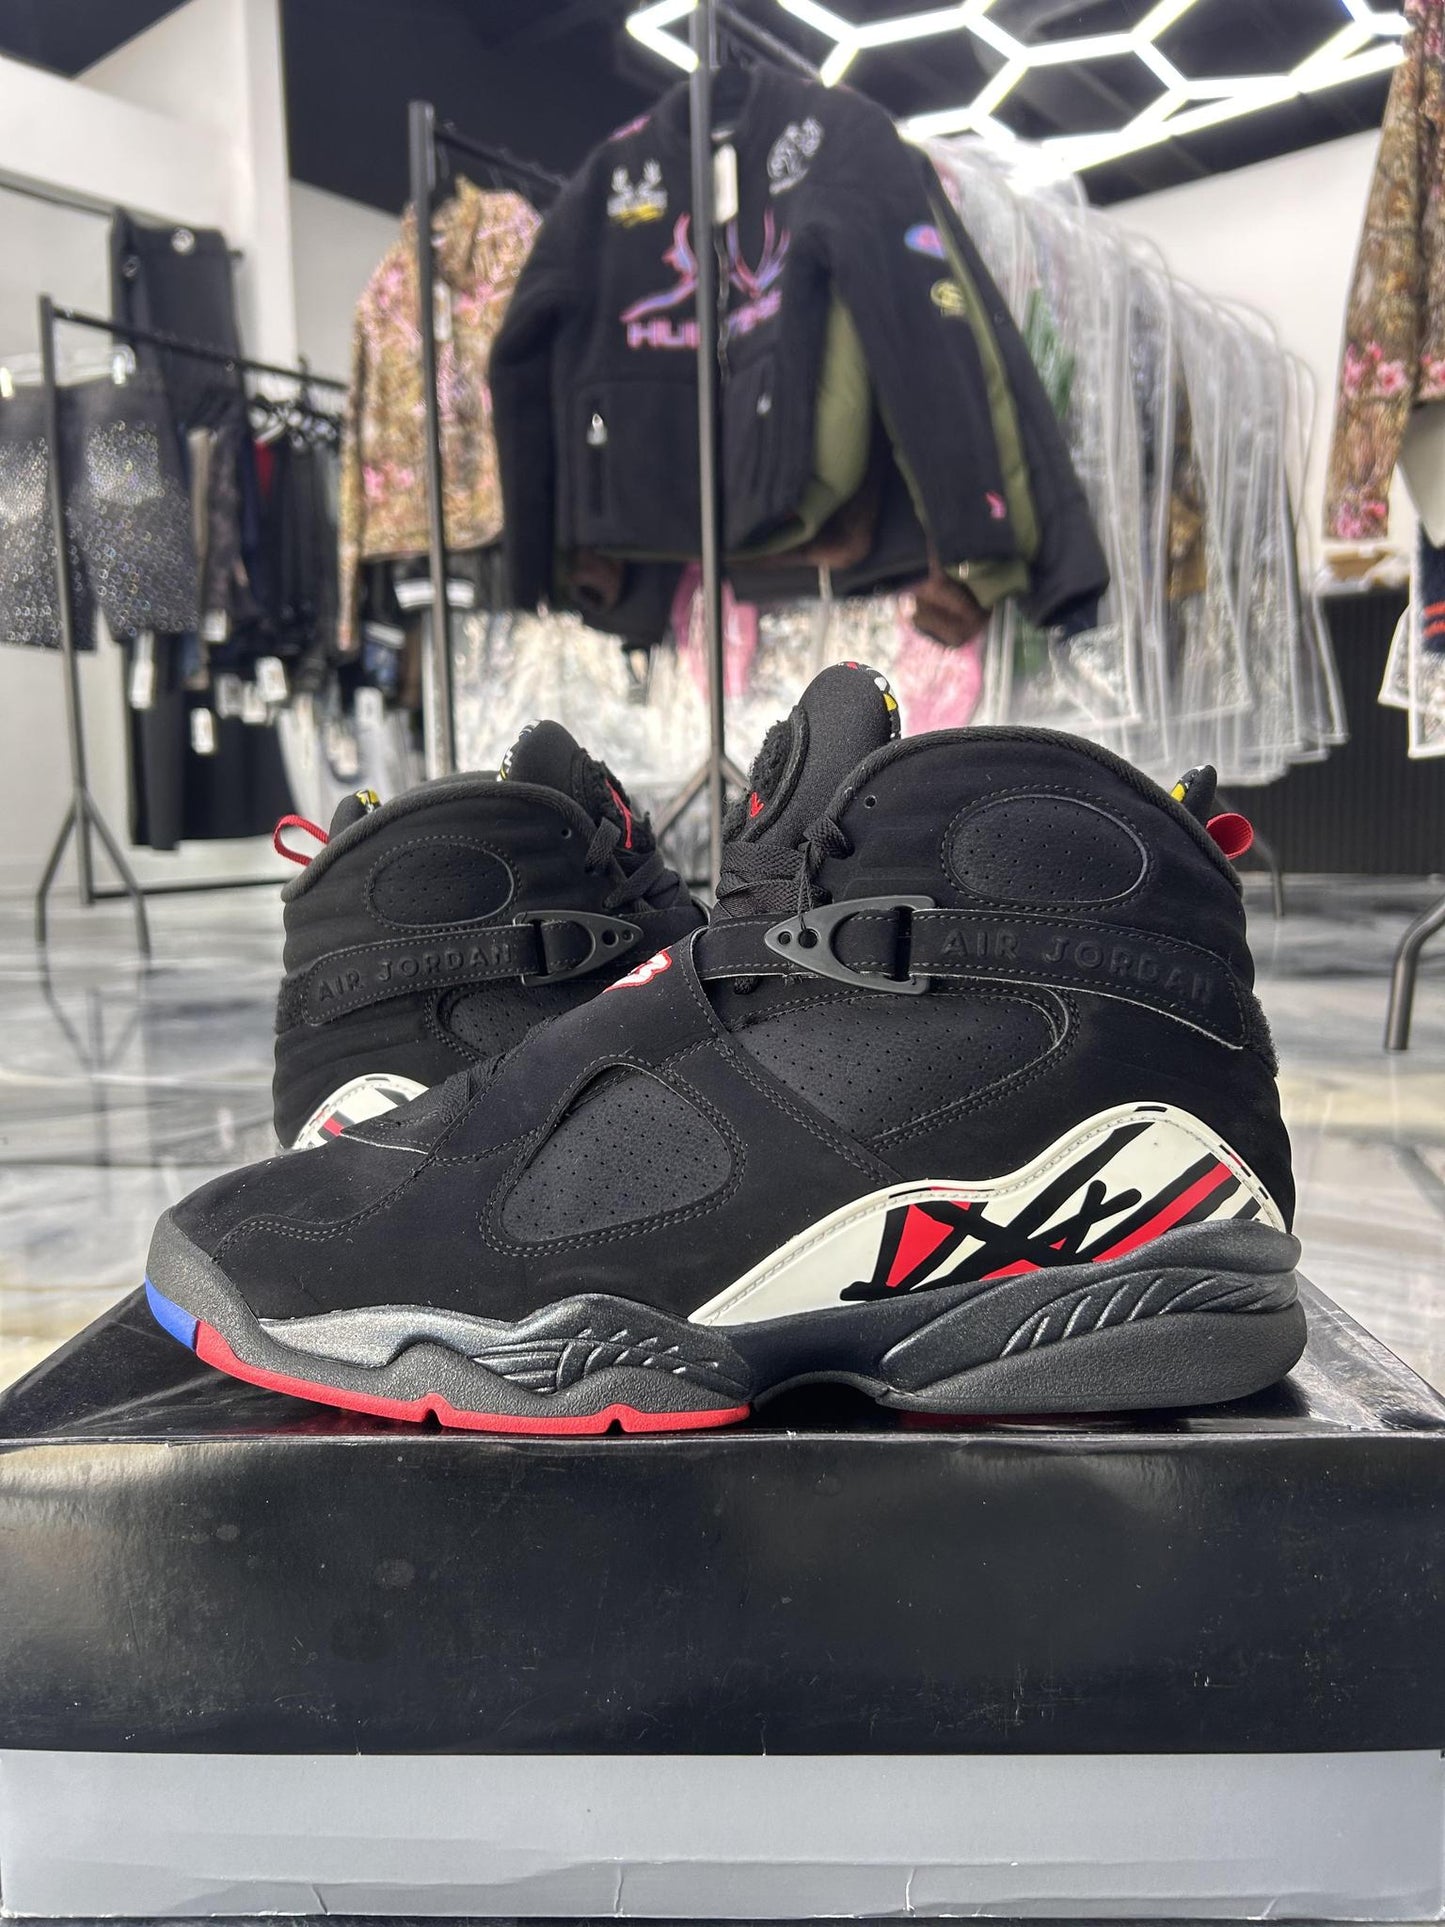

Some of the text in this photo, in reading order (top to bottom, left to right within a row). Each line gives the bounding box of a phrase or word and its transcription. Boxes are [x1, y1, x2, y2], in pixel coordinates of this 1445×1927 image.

[317, 942, 513, 1002] AIR JORDAN
[941, 929, 1214, 1001] AIR JORDAN
